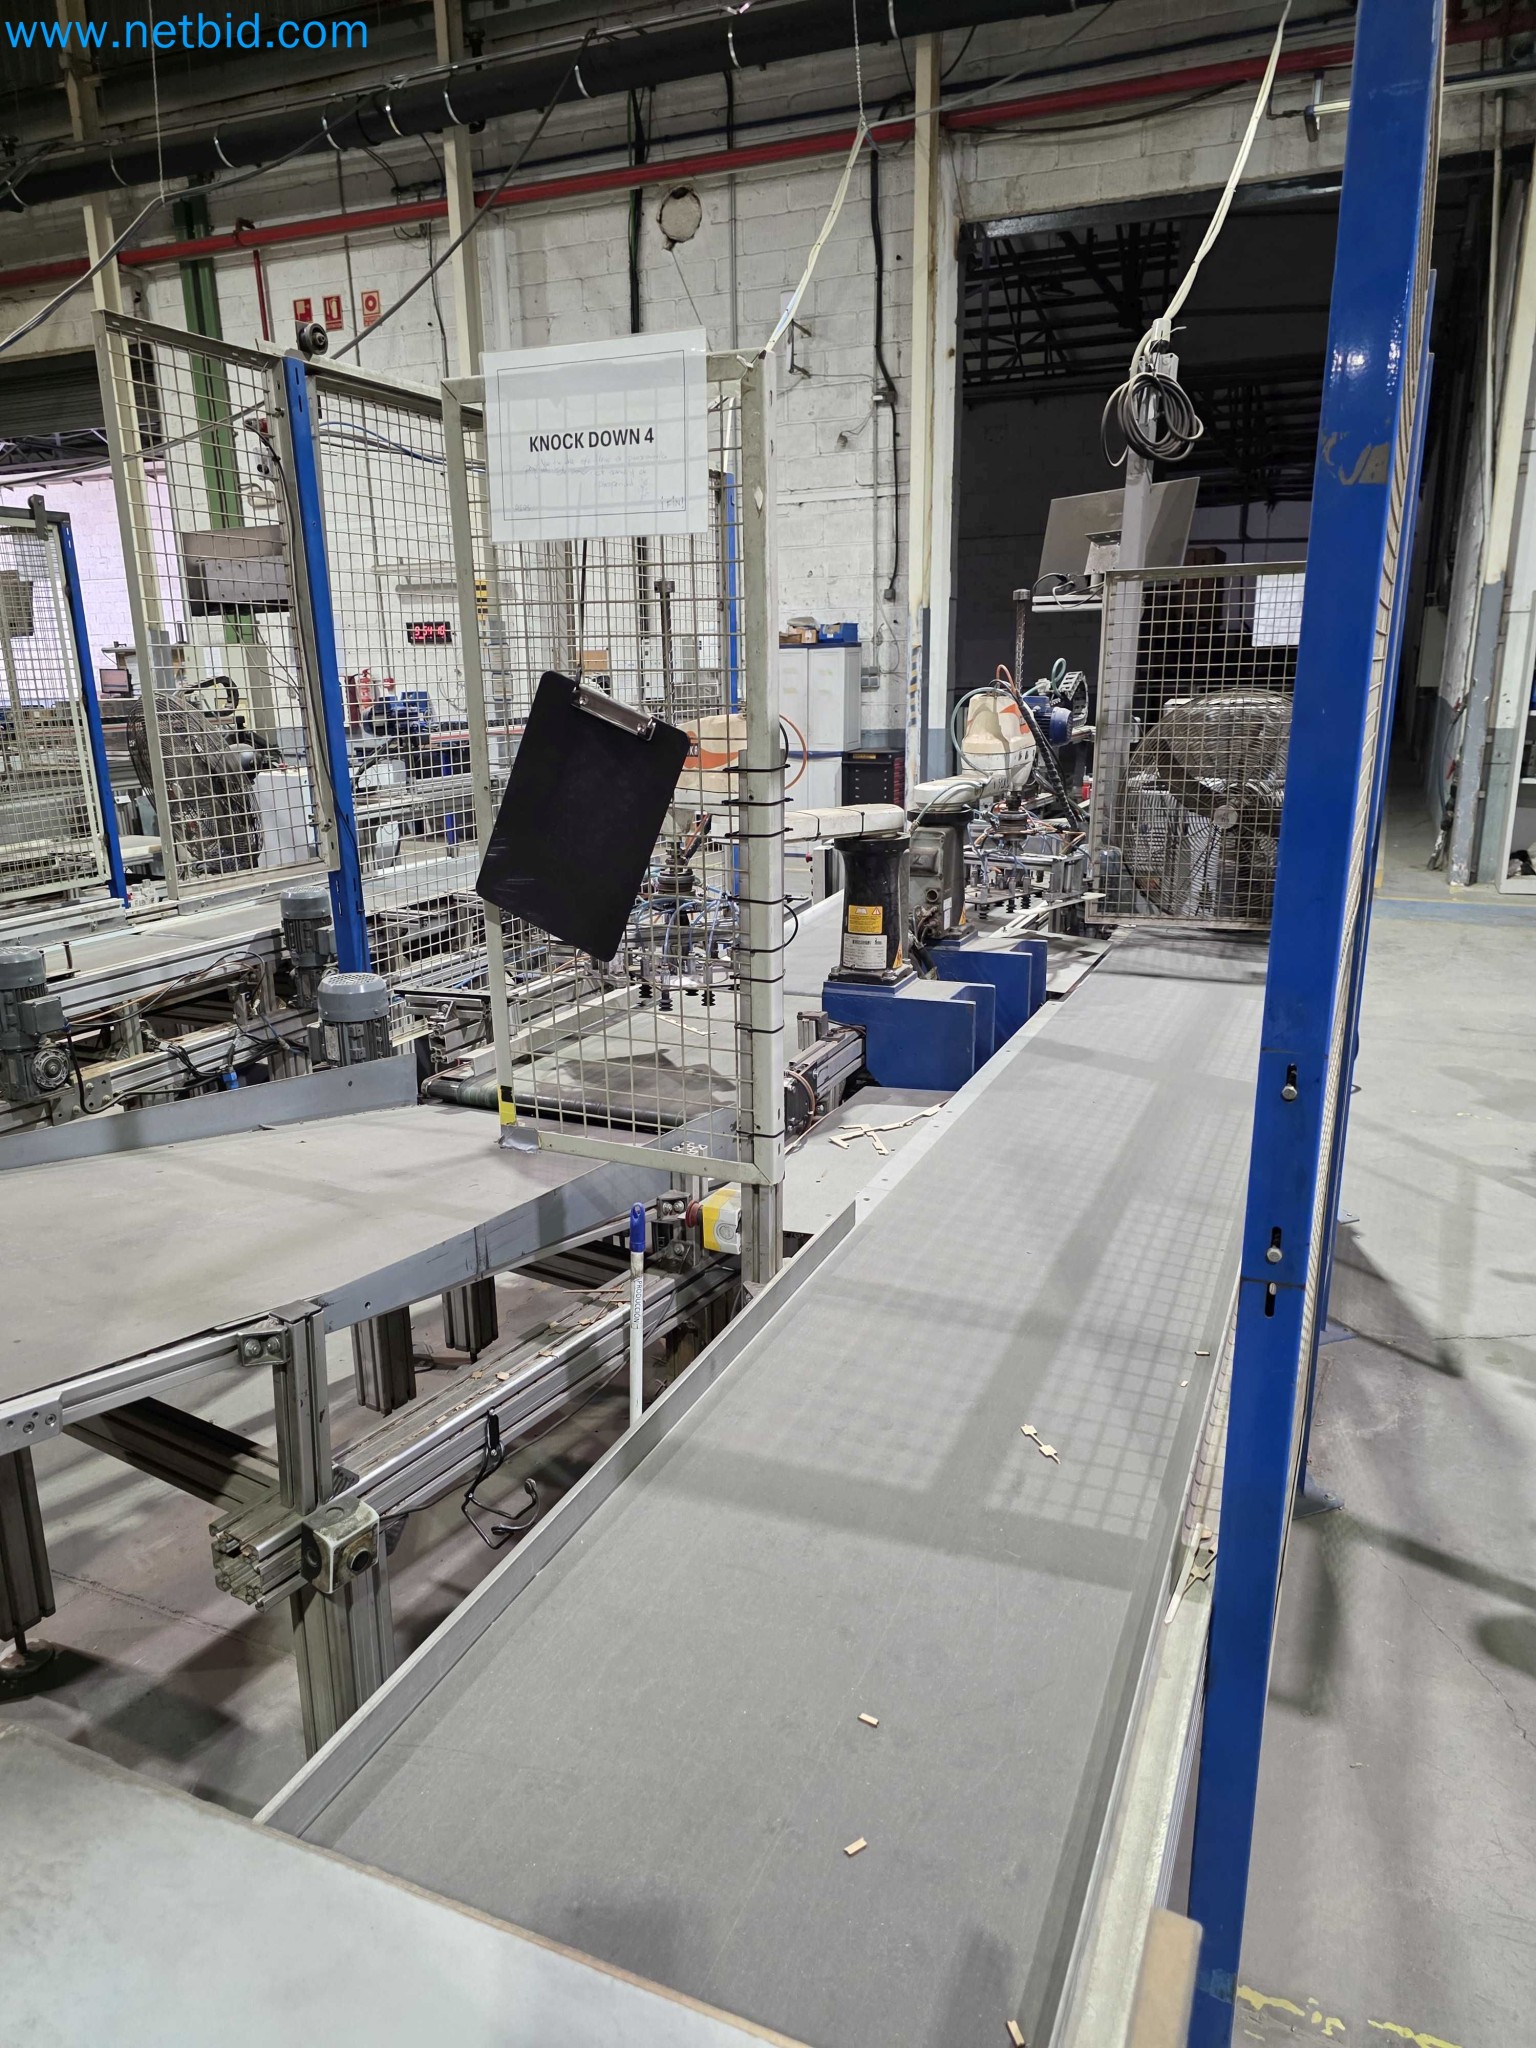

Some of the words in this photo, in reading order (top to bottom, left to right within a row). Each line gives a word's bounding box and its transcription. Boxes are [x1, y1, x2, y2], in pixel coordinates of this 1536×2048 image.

[529, 432, 585, 453] KNOCK
[588, 428, 641, 448] DOWN
[644, 427, 655, 444] 4
